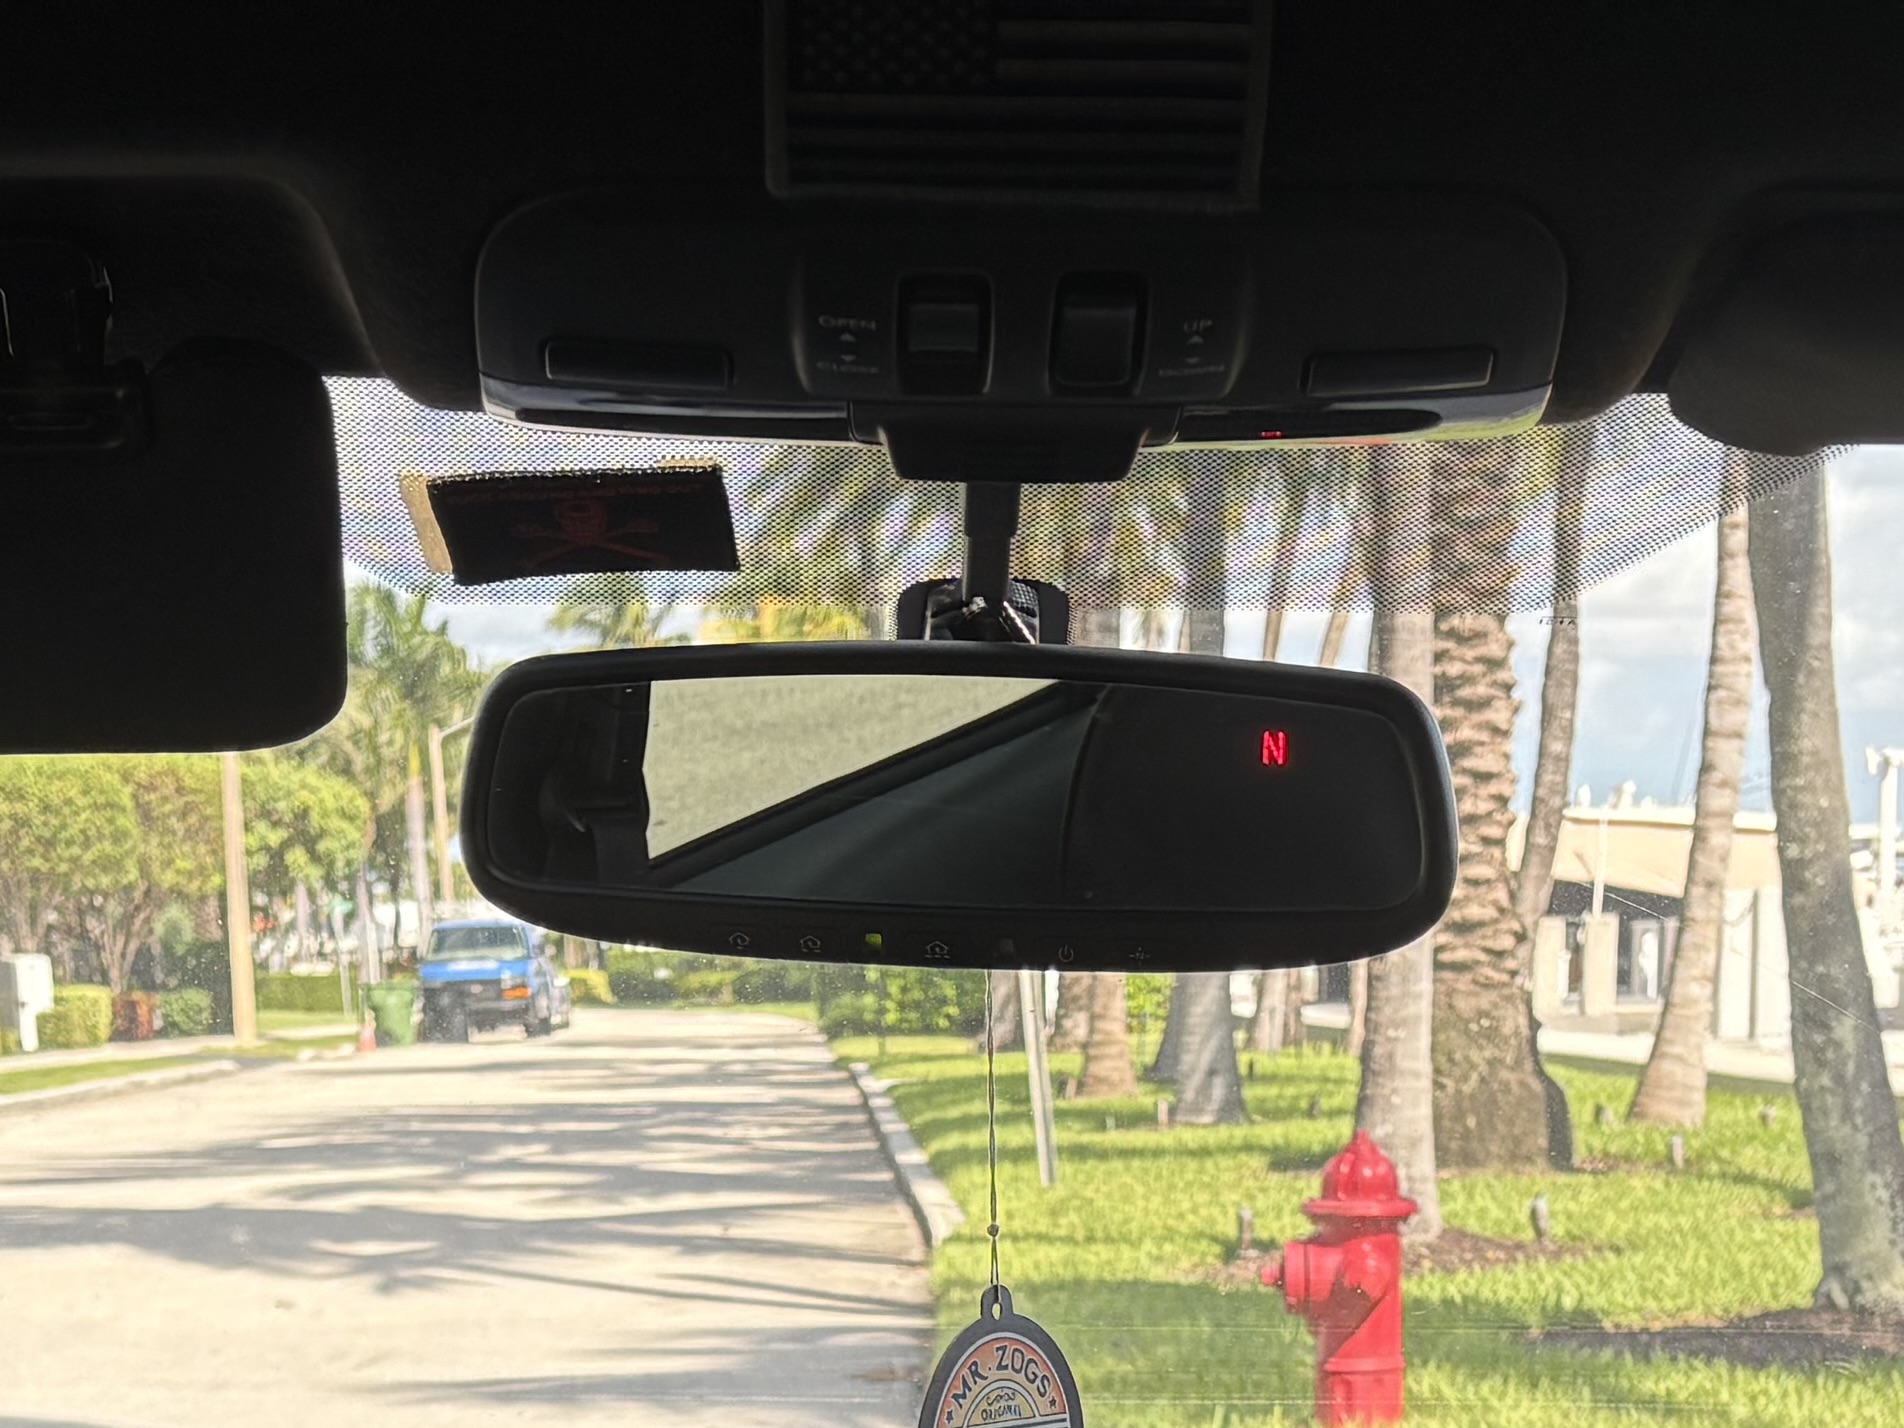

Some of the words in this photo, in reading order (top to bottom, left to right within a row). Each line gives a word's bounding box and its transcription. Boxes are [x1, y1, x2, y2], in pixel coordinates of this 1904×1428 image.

[1261, 730, 1288, 766] N
[951, 1359, 992, 1410] MR.
[994, 1344, 1052, 1399] ZOGS
